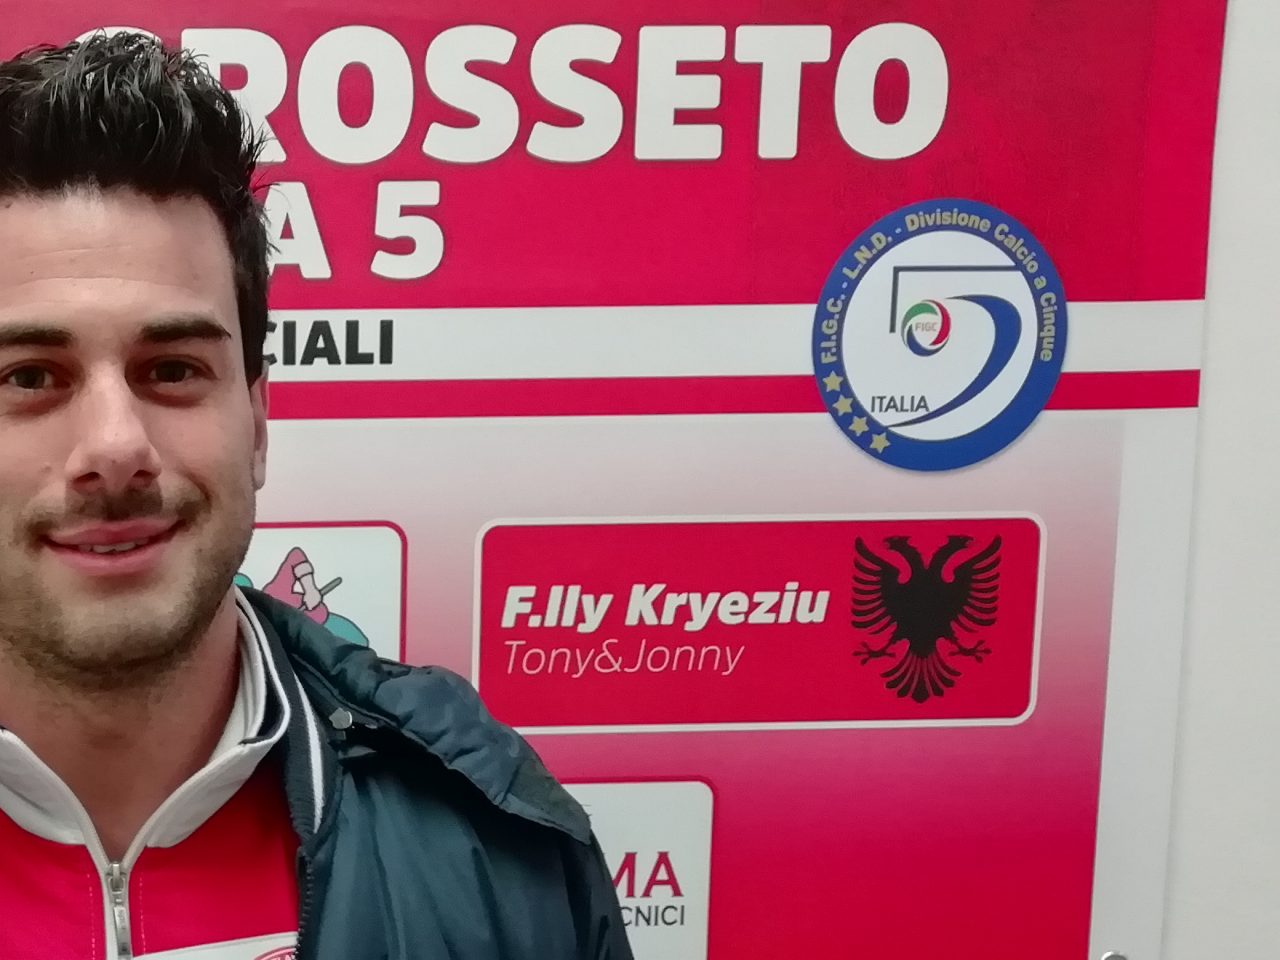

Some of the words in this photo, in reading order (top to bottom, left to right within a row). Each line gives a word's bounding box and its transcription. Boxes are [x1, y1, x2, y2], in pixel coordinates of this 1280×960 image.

[65, 25, 949, 164] ROSSETO
[260, 181, 332, 280] A
[371, 180, 445, 280] 5
[905, 208, 991, 233] Divisione
[842, 231, 893, 281] L.N.D.
[994, 223, 1039, 274] Calcio
[1034, 276, 1047, 290] a
[263, 319, 394, 366] IALI
[821, 294, 846, 364] F.I.G.C.
[1039, 292, 1058, 362] Cinque
[870, 395, 930, 413] ITALIA
[625, 581, 831, 634] Kryeziu
[503, 638, 746, 678] Tony&Jonny
